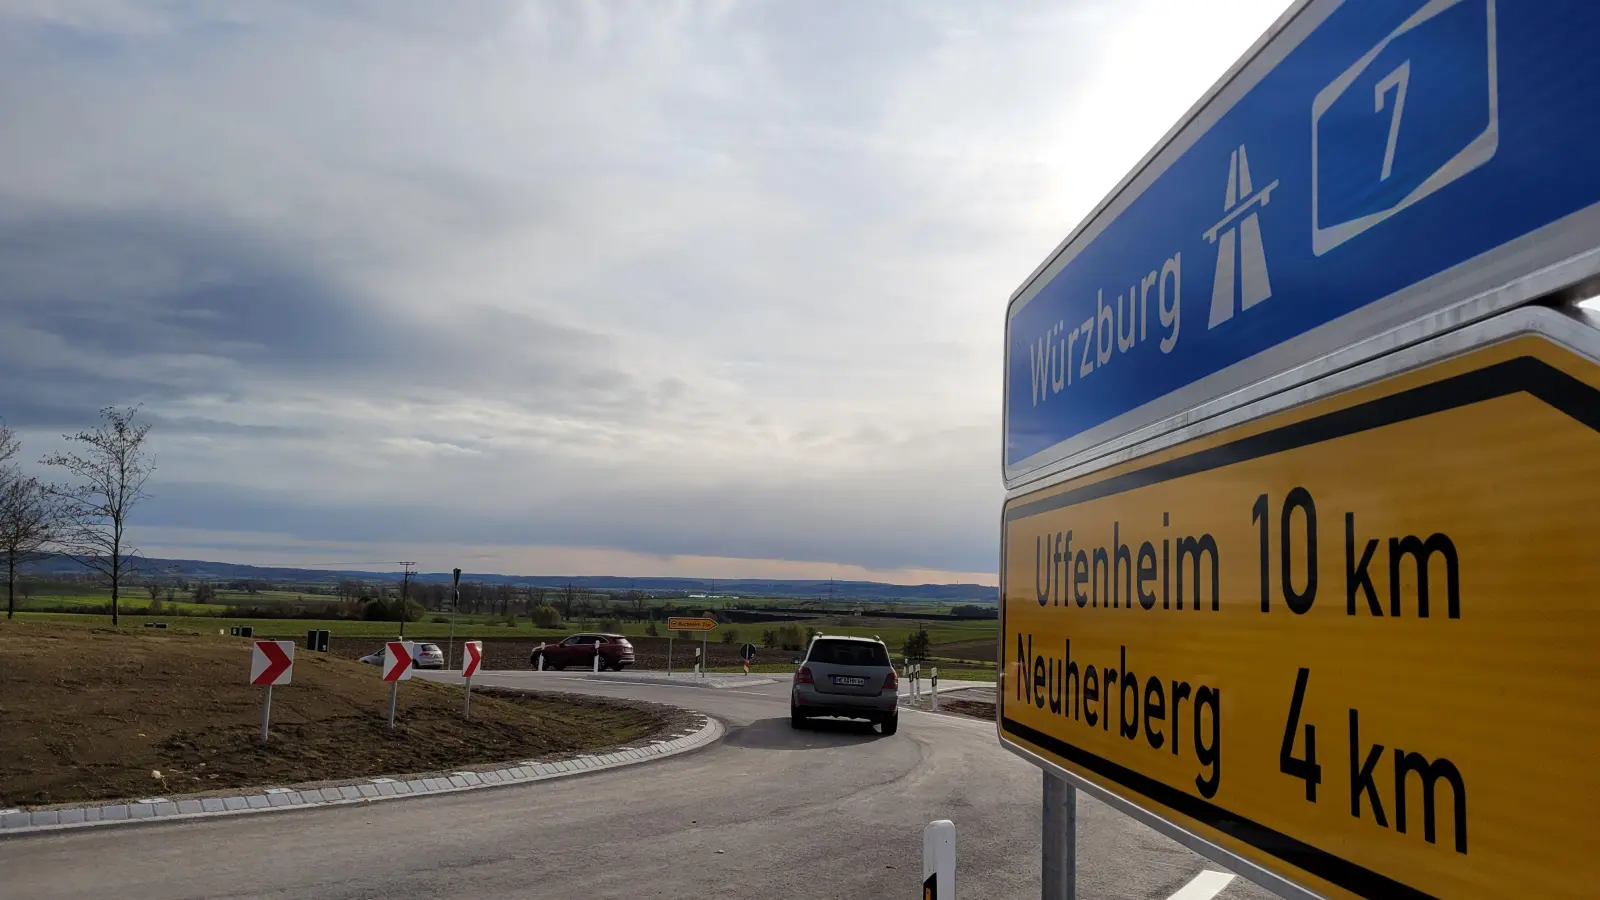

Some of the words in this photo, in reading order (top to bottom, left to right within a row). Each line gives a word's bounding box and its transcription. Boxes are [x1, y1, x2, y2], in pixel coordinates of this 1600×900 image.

[1374, 60, 1410, 182] 7
[1030, 251, 1181, 407] Würzburg
[1036, 511, 1220, 612] Uffenheim
[1252, 486, 1318, 616] 10
[1344, 511, 1461, 620] km
[1017, 632, 1221, 800] Neuherberg
[1279, 667, 1322, 803] 4
[1348, 708, 1468, 856] km
